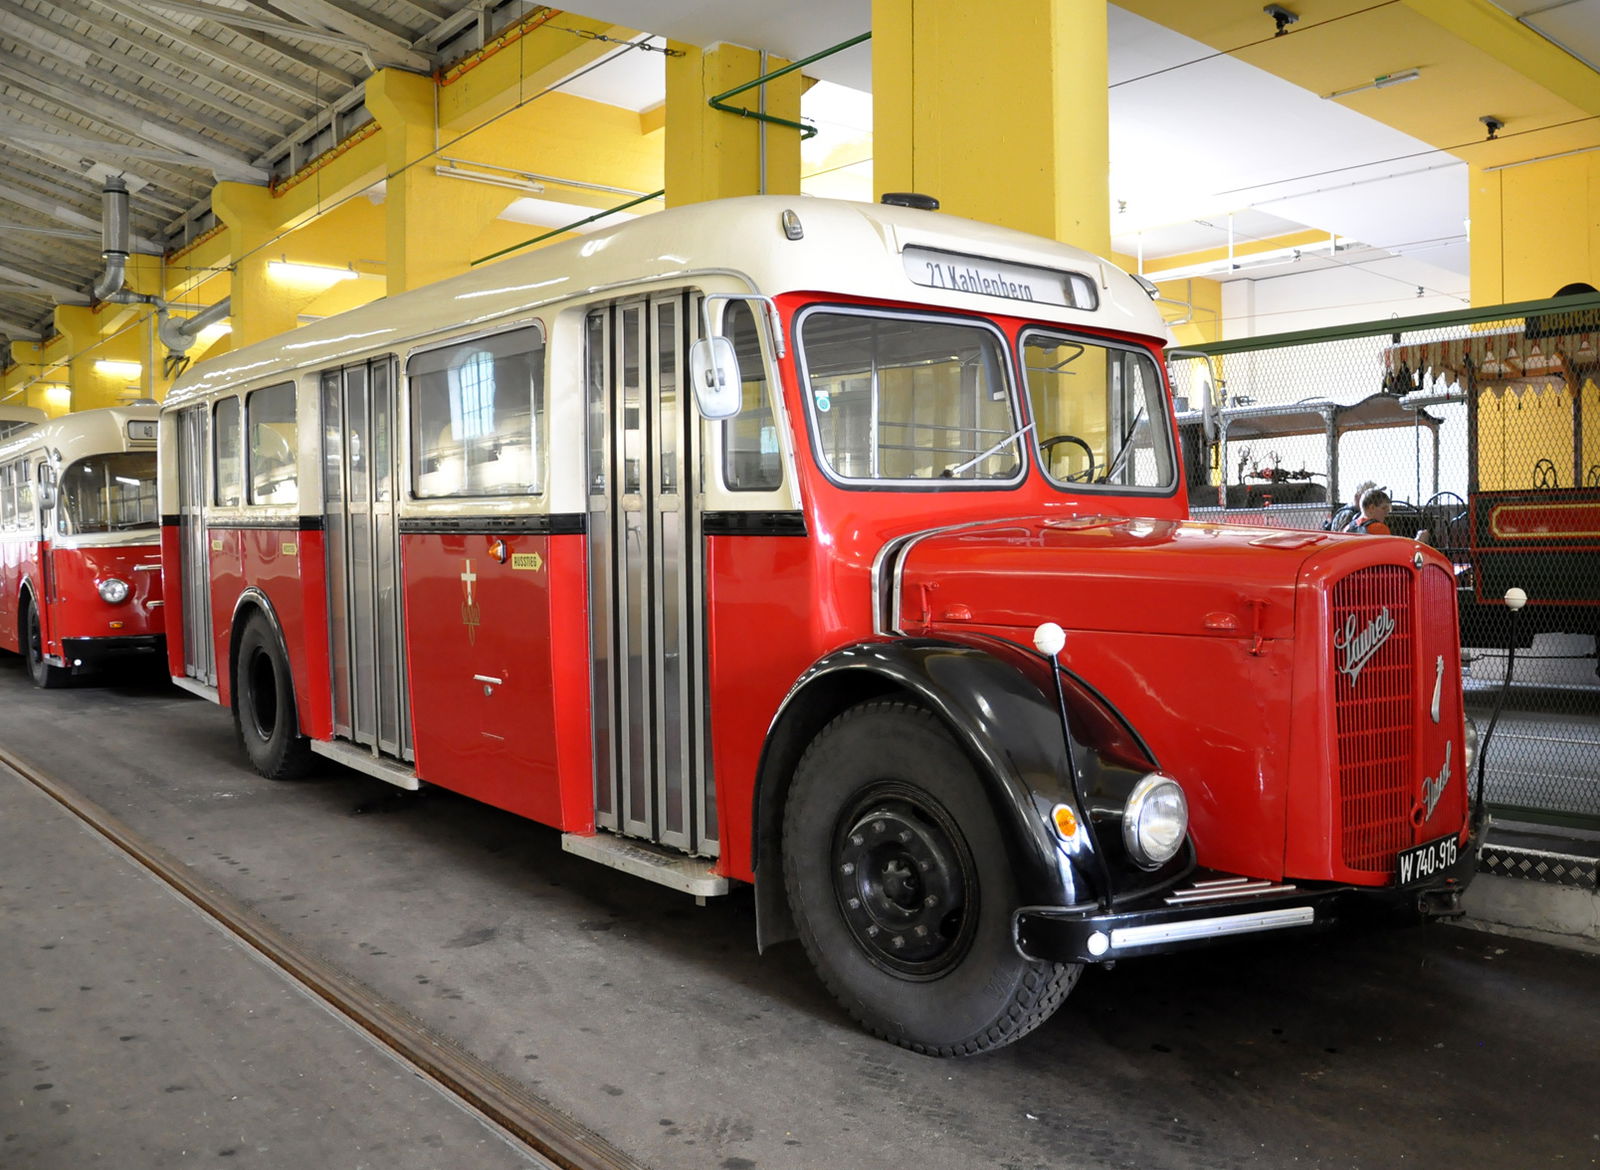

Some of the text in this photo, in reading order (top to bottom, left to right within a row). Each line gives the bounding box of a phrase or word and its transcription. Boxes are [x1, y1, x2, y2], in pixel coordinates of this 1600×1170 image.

[926, 261, 1034, 302] 21 Kahlenberg
[1334, 605, 1394, 687] Saurer
[1401, 853, 1414, 885] W
